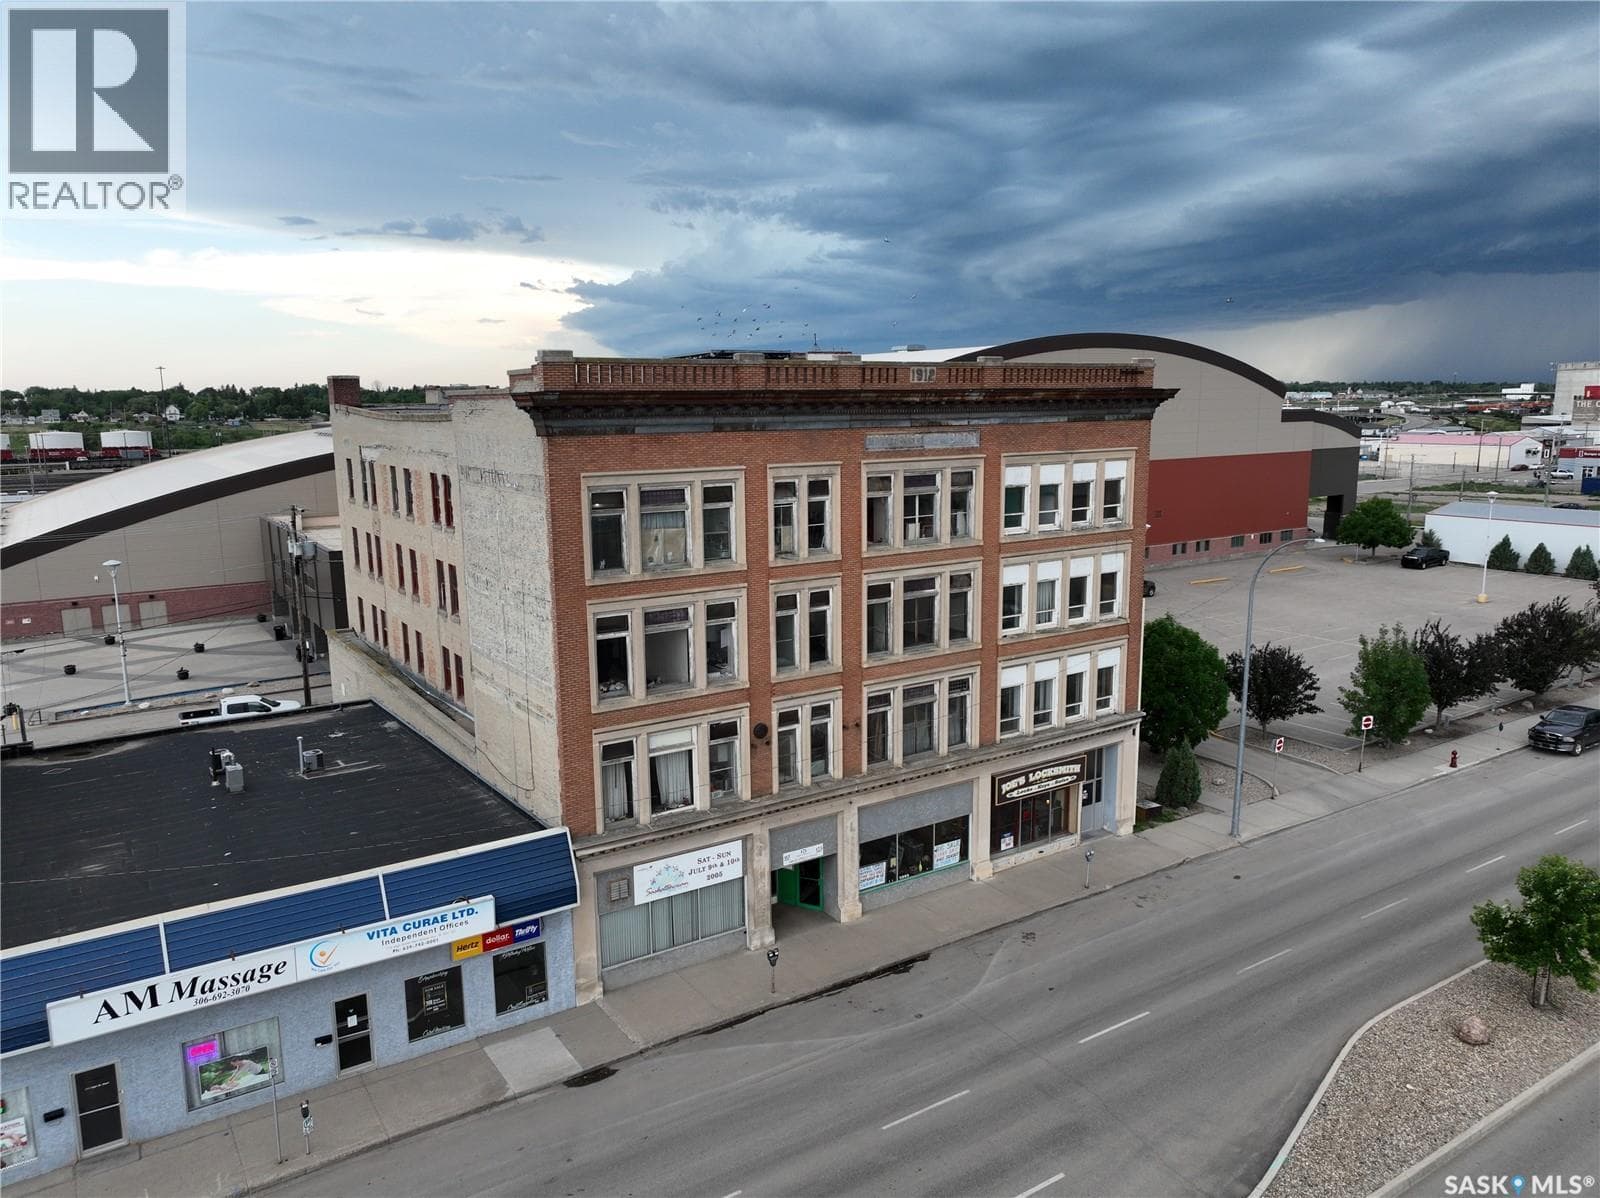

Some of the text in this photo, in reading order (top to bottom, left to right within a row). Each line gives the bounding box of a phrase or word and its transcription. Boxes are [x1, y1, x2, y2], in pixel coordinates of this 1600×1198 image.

[1576, 400, 1592, 408] THE
[1028, 763, 1081, 782] LOCKSMITH
[697, 855, 711, 865] SAT
[716, 850, 732, 860] SUN
[688, 865, 706, 876] JULY
[706, 871, 723, 881] 2005
[366, 907, 479, 941] VITA CURAE LTD.
[515, 924, 539, 937] Thrifty
[381, 927, 437, 946] Independent
[439, 919, 469, 931] Offices
[456, 941, 480, 952] Hertz
[92, 960, 287, 1025] AM Massage
[193, 984, 251, 1007] 306-692-3070
